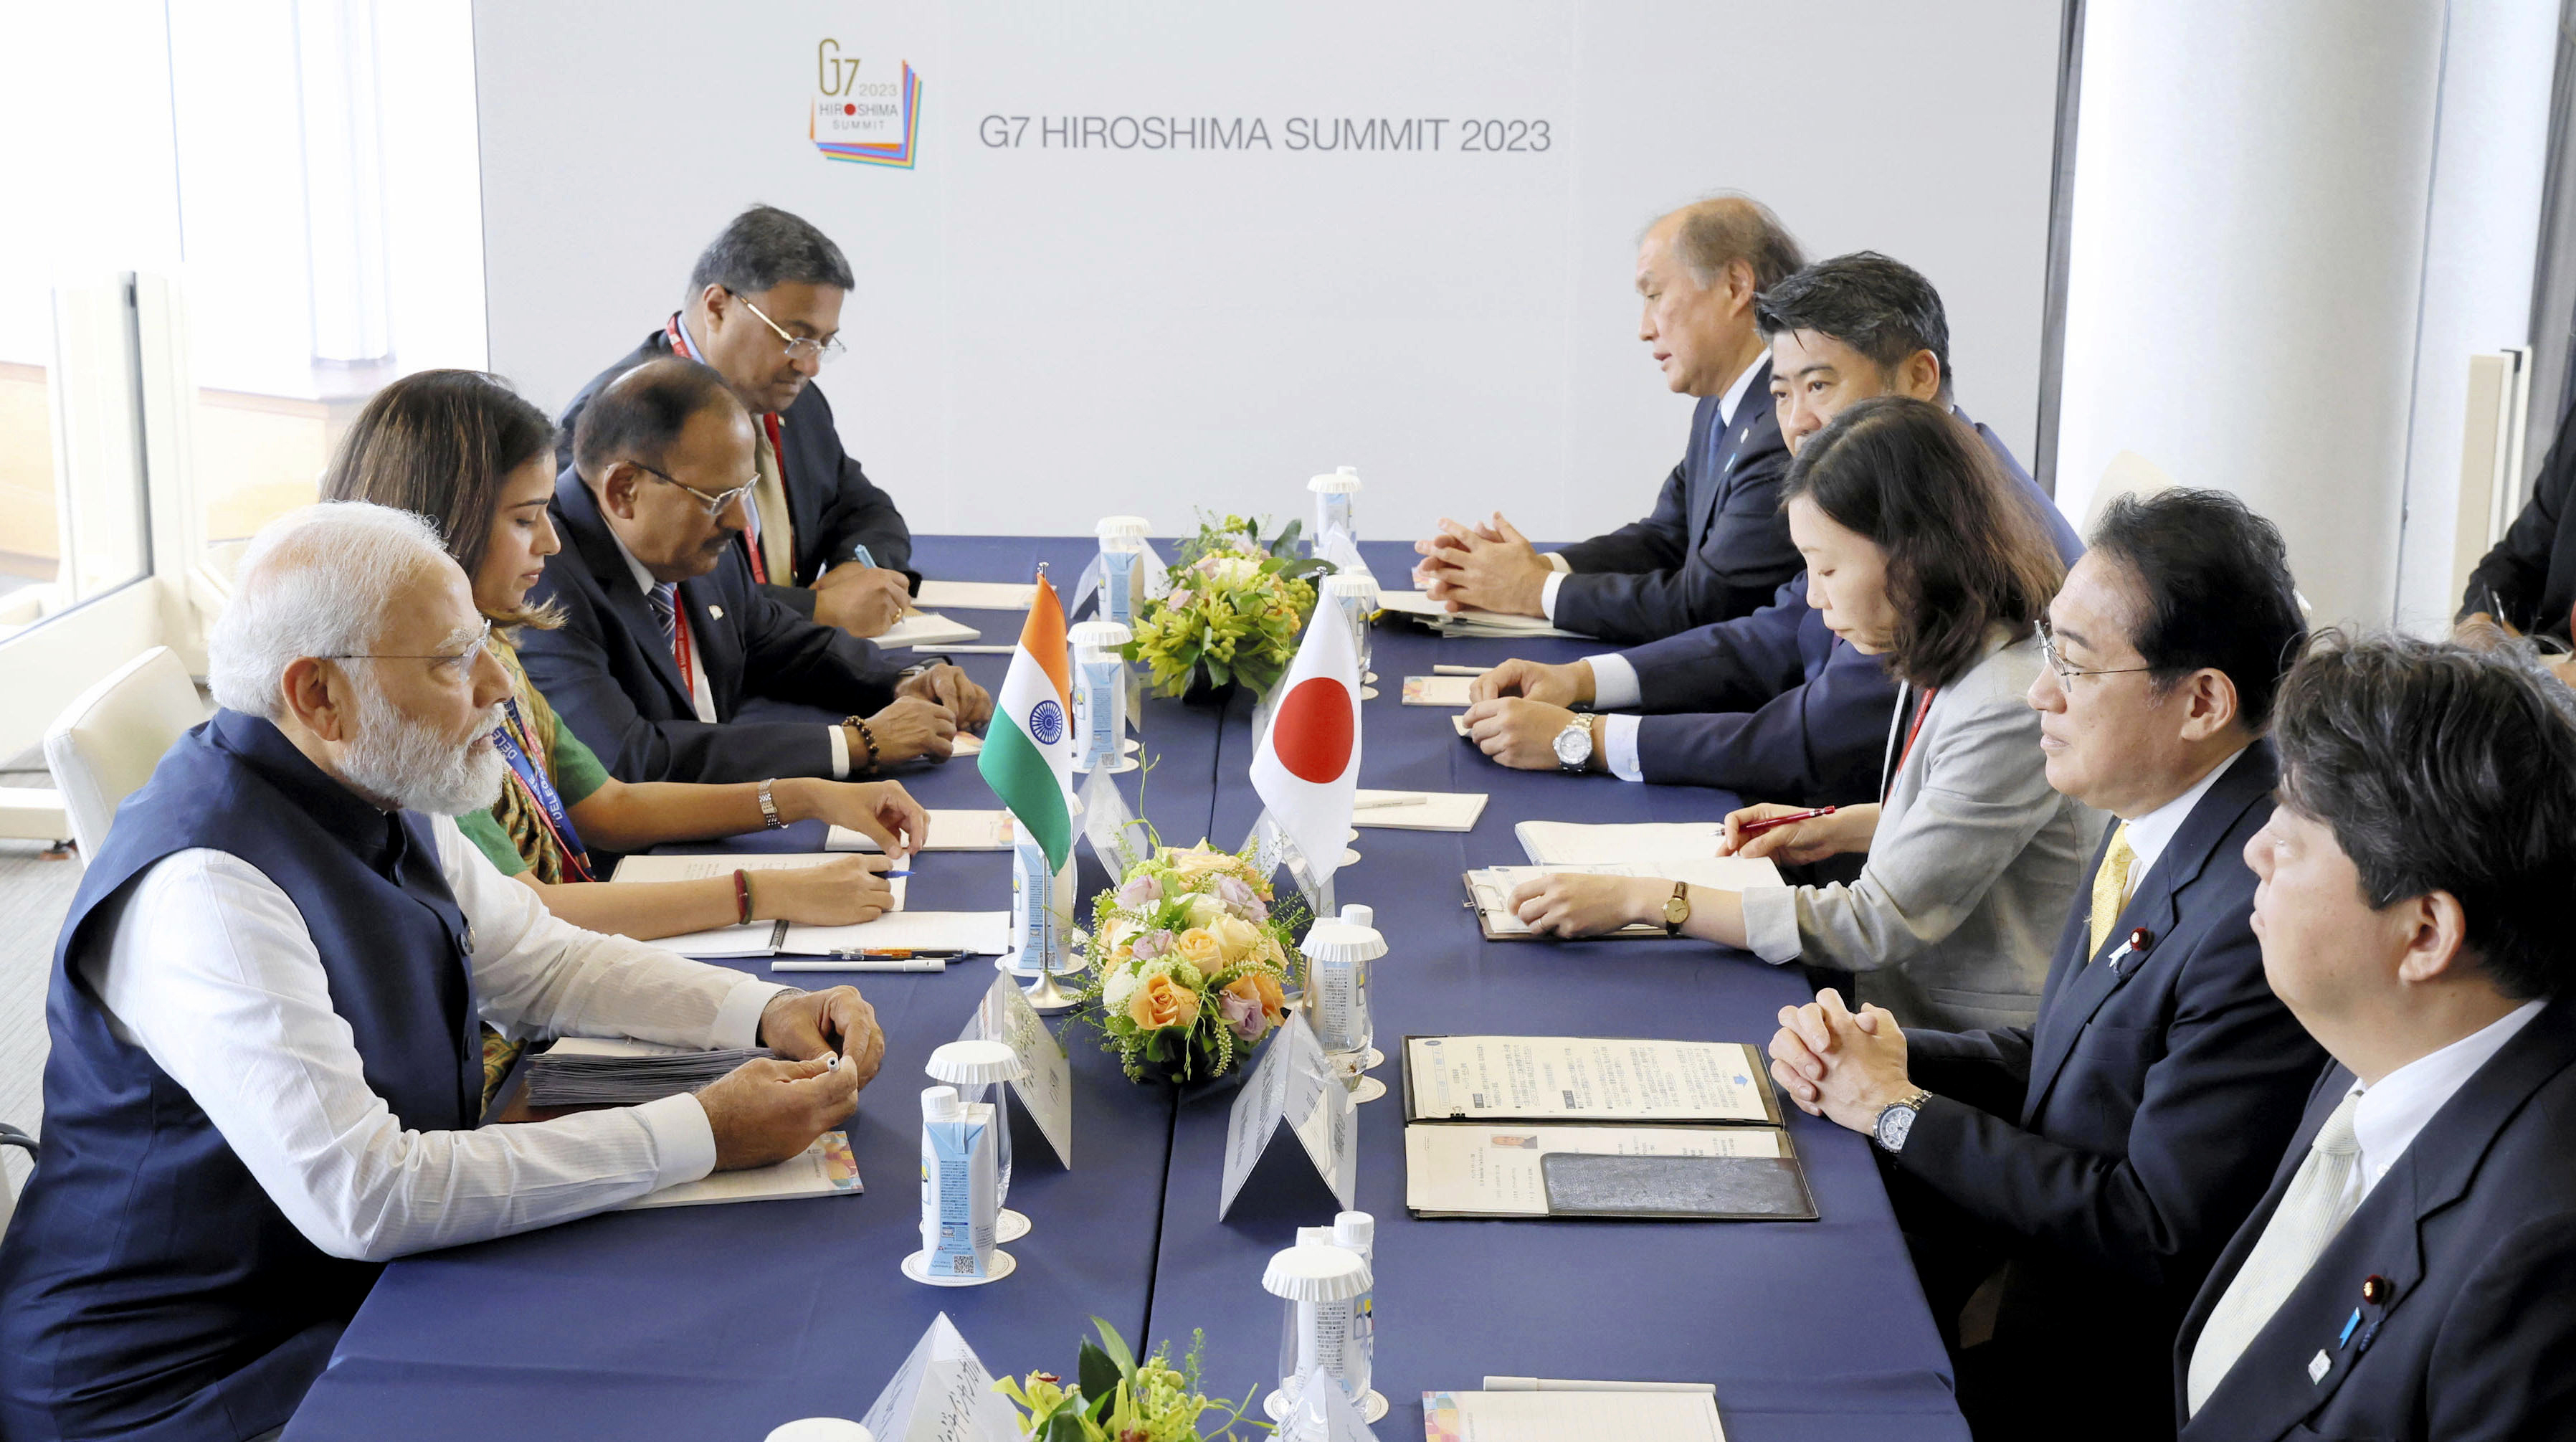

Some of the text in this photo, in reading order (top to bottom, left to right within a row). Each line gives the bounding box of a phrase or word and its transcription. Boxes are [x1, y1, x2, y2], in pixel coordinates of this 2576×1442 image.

[819, 38, 898, 97] G7 2023
[833, 120, 885, 130] SUMMIT
[979, 115, 1551, 152] G7 HIROSHIMA SUMMIT 2023
[492, 729, 518, 759] DELE
